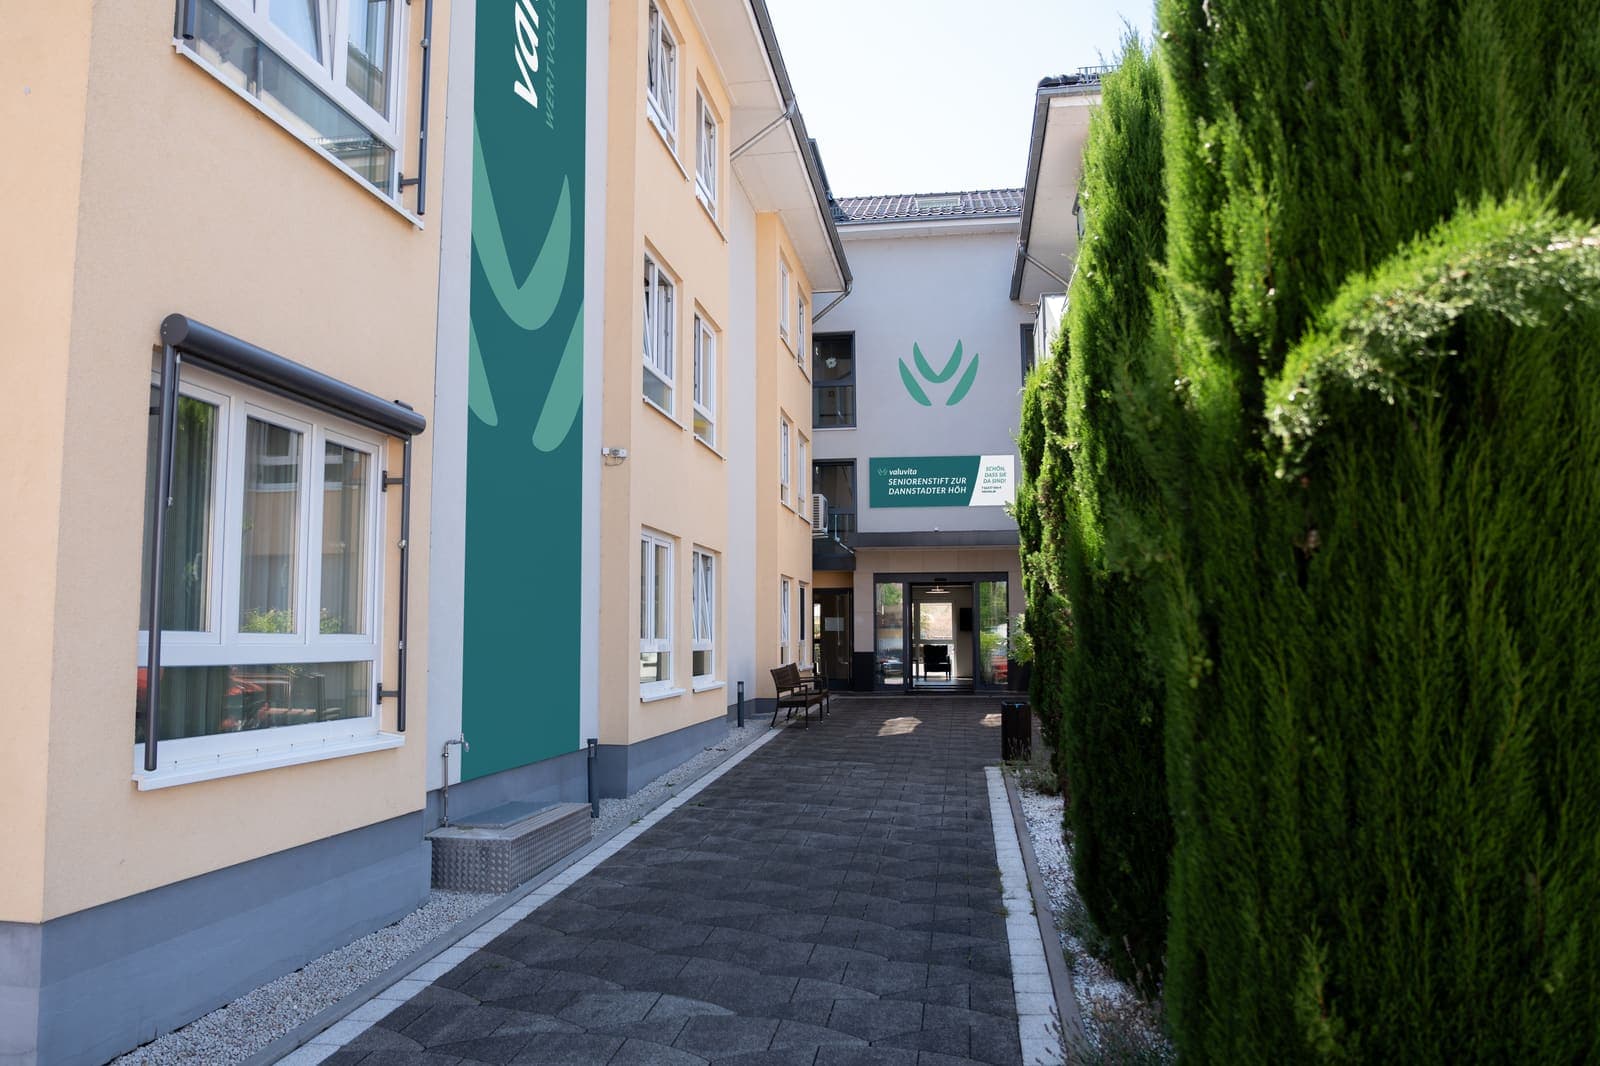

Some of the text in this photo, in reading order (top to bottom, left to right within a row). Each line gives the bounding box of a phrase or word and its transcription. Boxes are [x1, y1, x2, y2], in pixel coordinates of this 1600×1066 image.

[888, 467, 918, 476] valuvita
[888, 476, 967, 486] SENIORENSTIFT ZUR
[888, 485, 967, 496] DANNSTADTER HÖH
